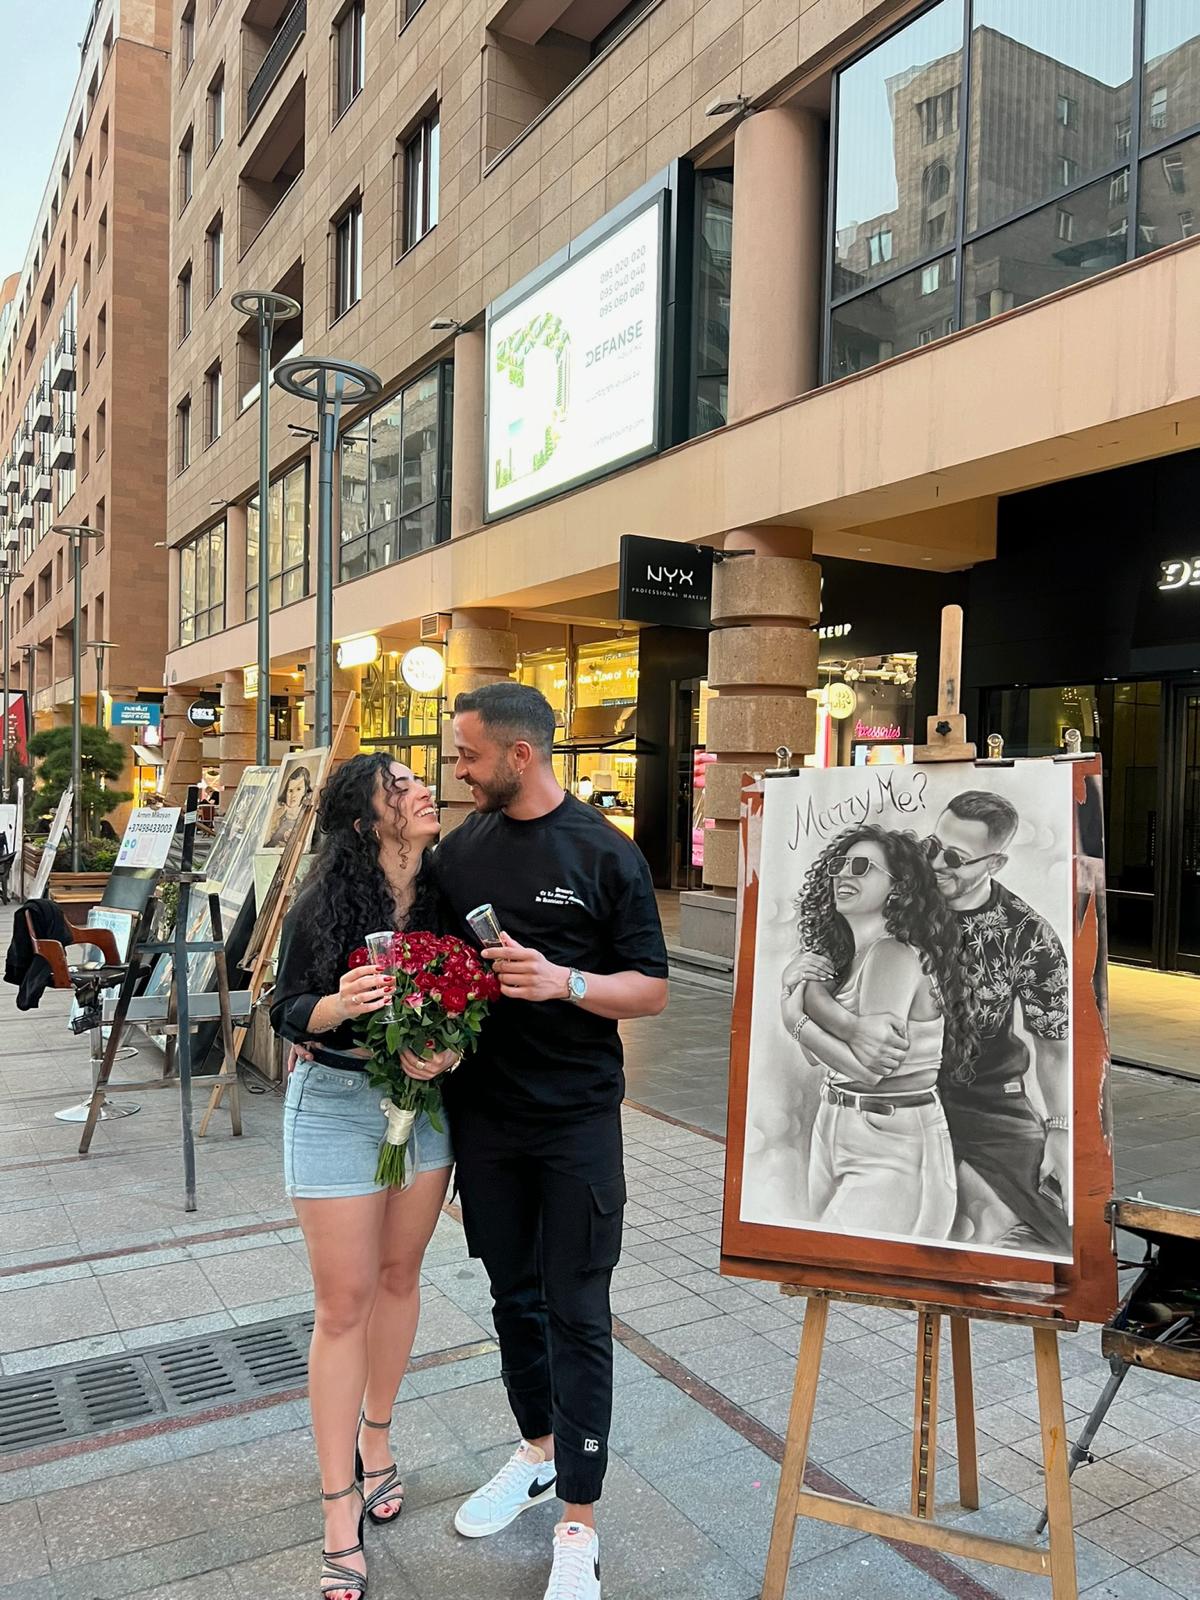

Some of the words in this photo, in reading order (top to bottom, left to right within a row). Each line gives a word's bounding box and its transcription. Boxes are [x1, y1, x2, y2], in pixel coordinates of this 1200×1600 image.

[600, 267, 613, 284] 095
[600, 284, 613, 301] 095
[600, 301, 613, 318] 095
[585, 319, 644, 369] DEFANSE
[647, 564, 694, 587] NYX
[631, 586, 679, 598] PROFESSIONAL
[683, 593, 708, 601] MAKEUP
[813, 623, 852, 640] KEUP
[855, 718, 901, 738] Accessories
[787, 786, 870, 851] Marry
[875, 769, 928, 814] Me?
[584, 1438, 599, 1452] DG
